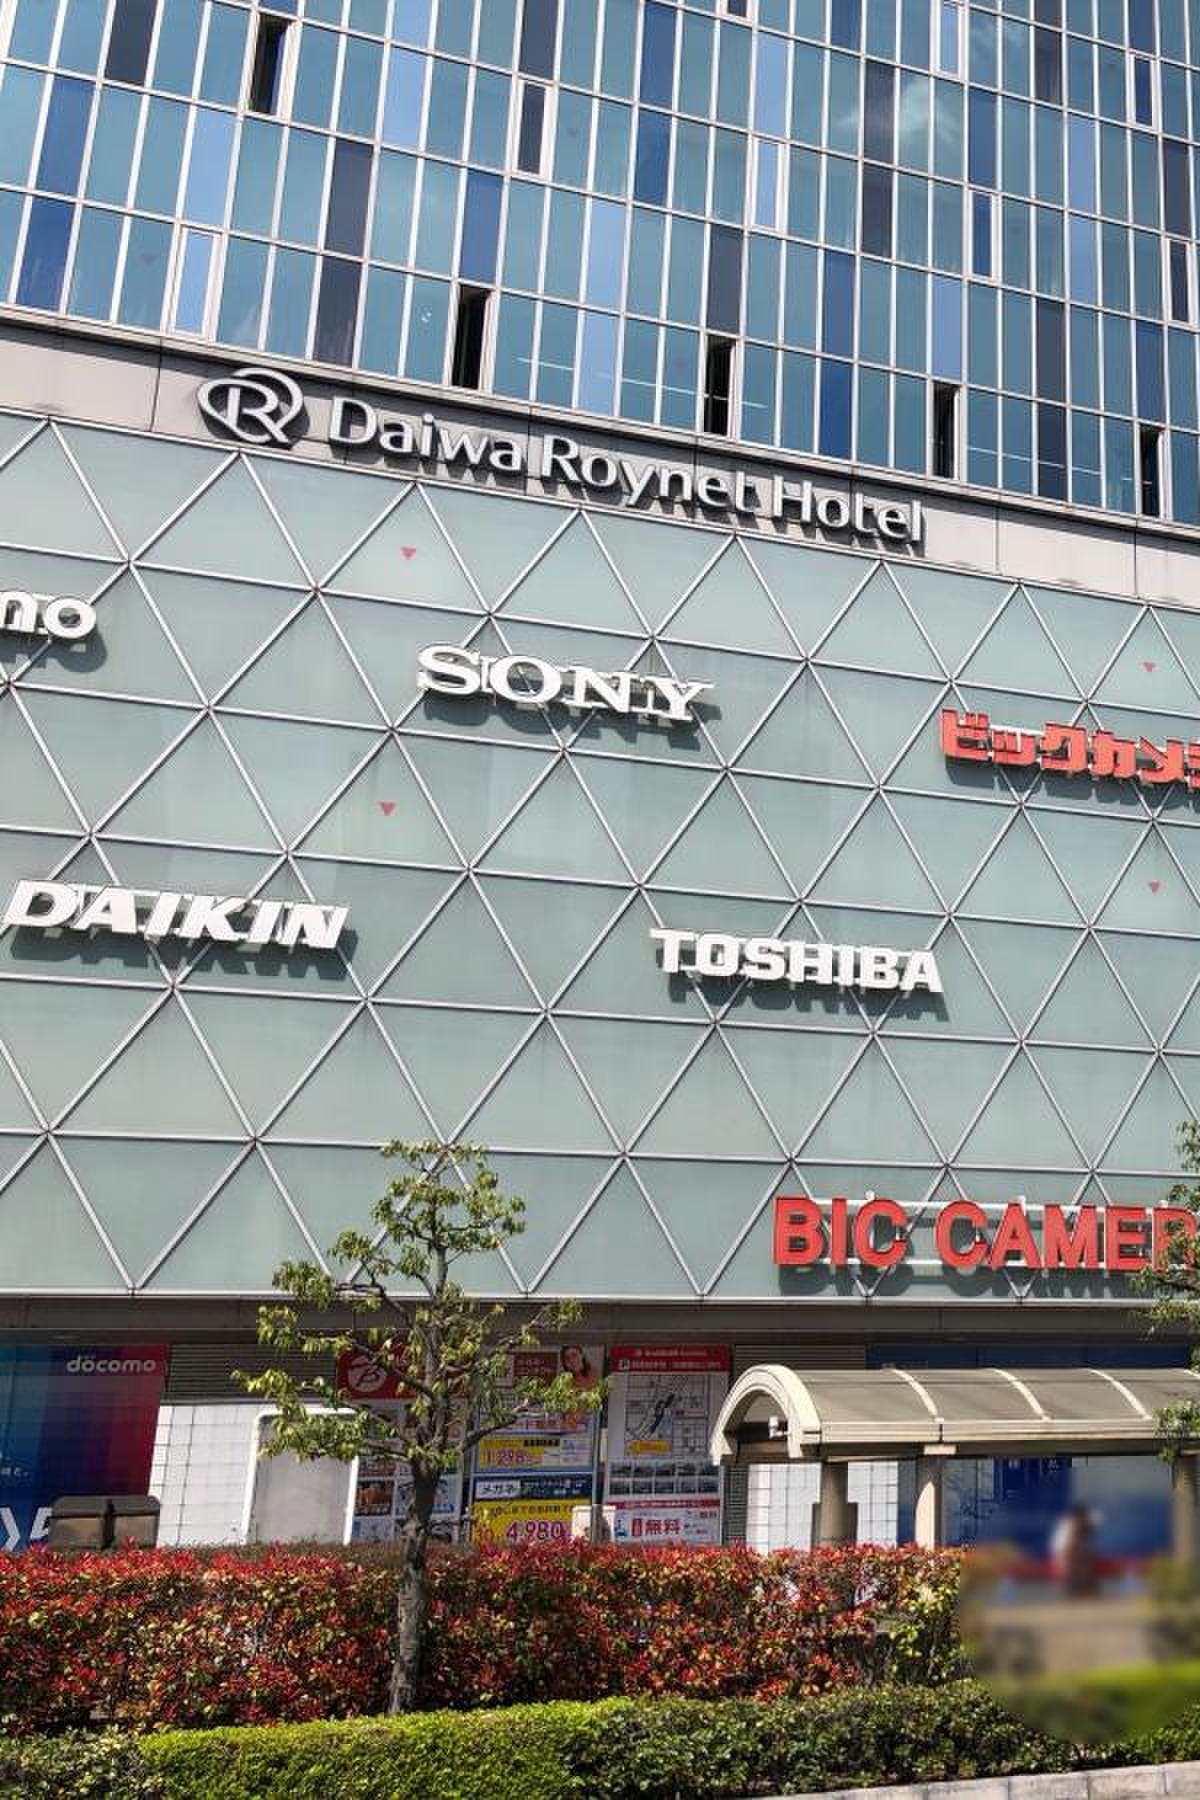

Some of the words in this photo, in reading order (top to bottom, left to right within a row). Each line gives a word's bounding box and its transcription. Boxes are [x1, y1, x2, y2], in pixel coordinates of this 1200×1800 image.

[328, 396, 522, 472] Daiwa
[541, 435, 753, 512] Roynet
[772, 474, 922, 542] Hotel
[416, 642, 714, 721] SONY
[3, 879, 349, 950] DAIKIN
[650, 927, 943, 993] TOSHIBA
[773, 1196, 908, 1268] BIC
[66, 1355, 156, 1374] docomo
